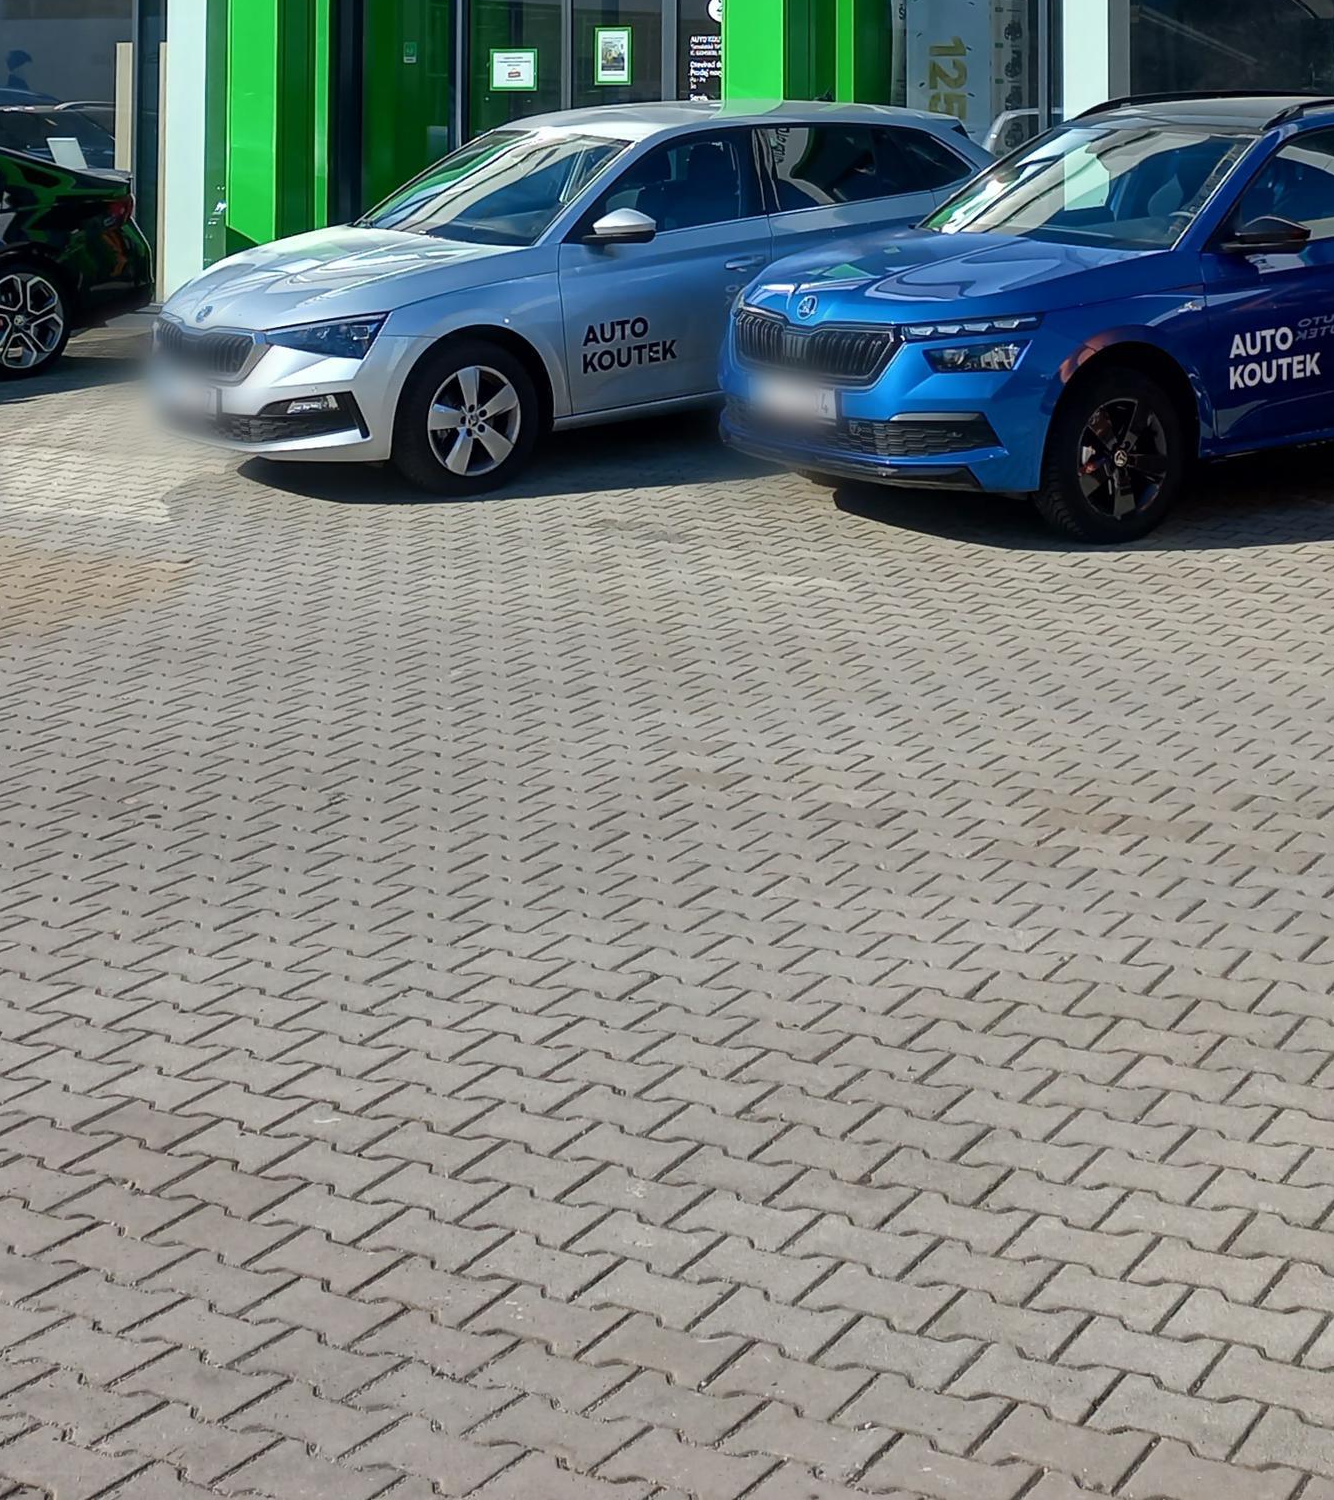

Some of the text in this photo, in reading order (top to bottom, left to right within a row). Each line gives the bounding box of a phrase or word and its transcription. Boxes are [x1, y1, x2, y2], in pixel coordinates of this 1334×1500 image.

[582, 316, 649, 347] AUTO
[1229, 326, 1294, 359] AUTO
[582, 339, 677, 375] KOUTEK
[1229, 352, 1321, 390] KOUTEK
